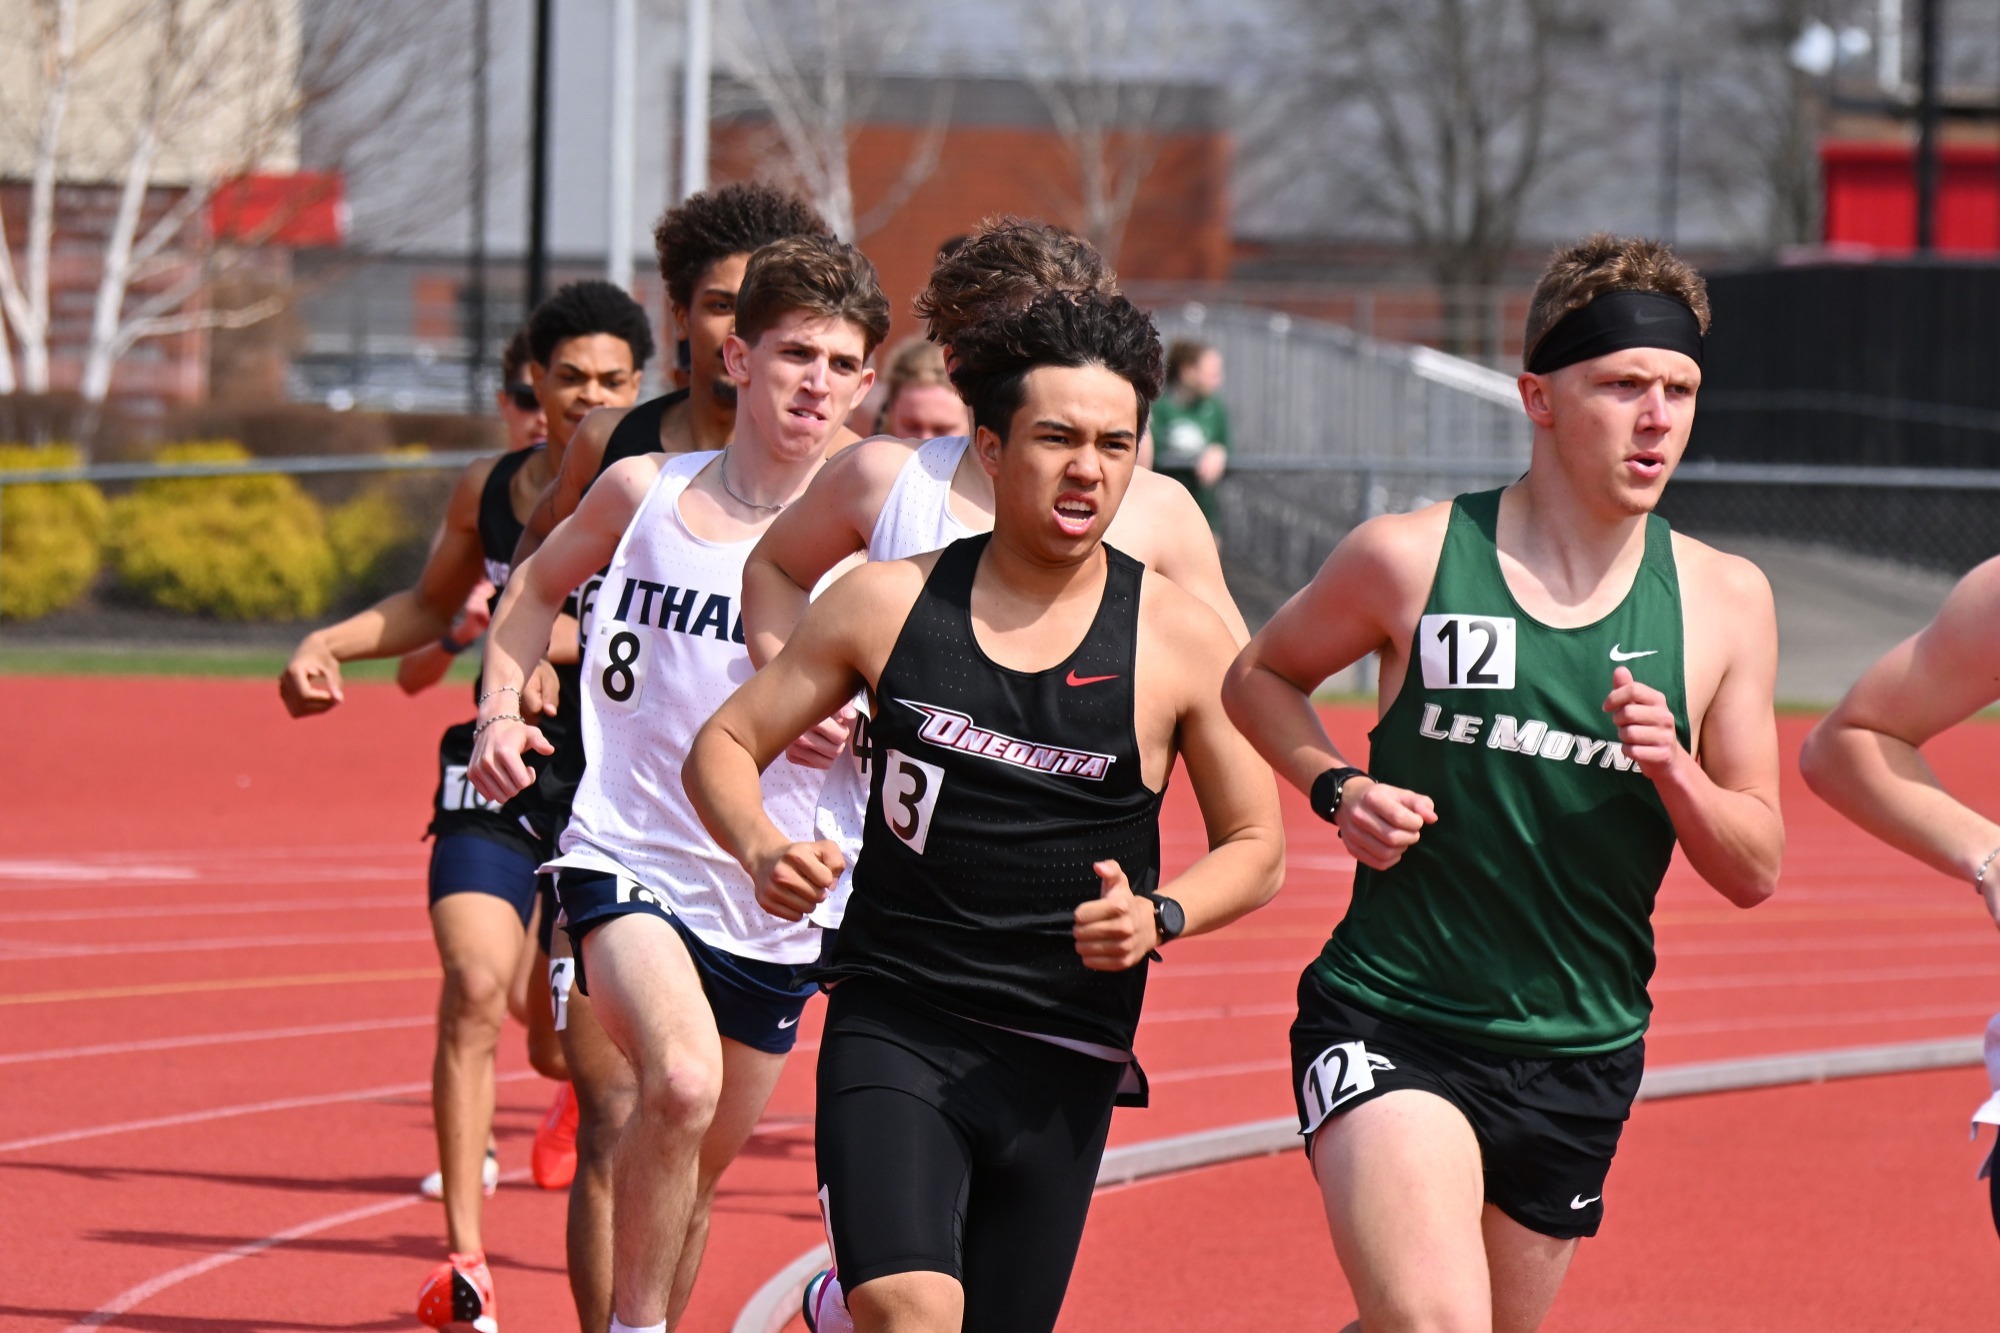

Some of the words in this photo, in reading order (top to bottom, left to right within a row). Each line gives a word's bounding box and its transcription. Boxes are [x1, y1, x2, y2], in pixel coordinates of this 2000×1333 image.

[602, 631, 641, 702] 8
[1436, 620, 1499, 685] 12
[1487, 714, 1643, 773] MOYN
[892, 761, 928, 841] 3
[1308, 1047, 1358, 1118] 12
